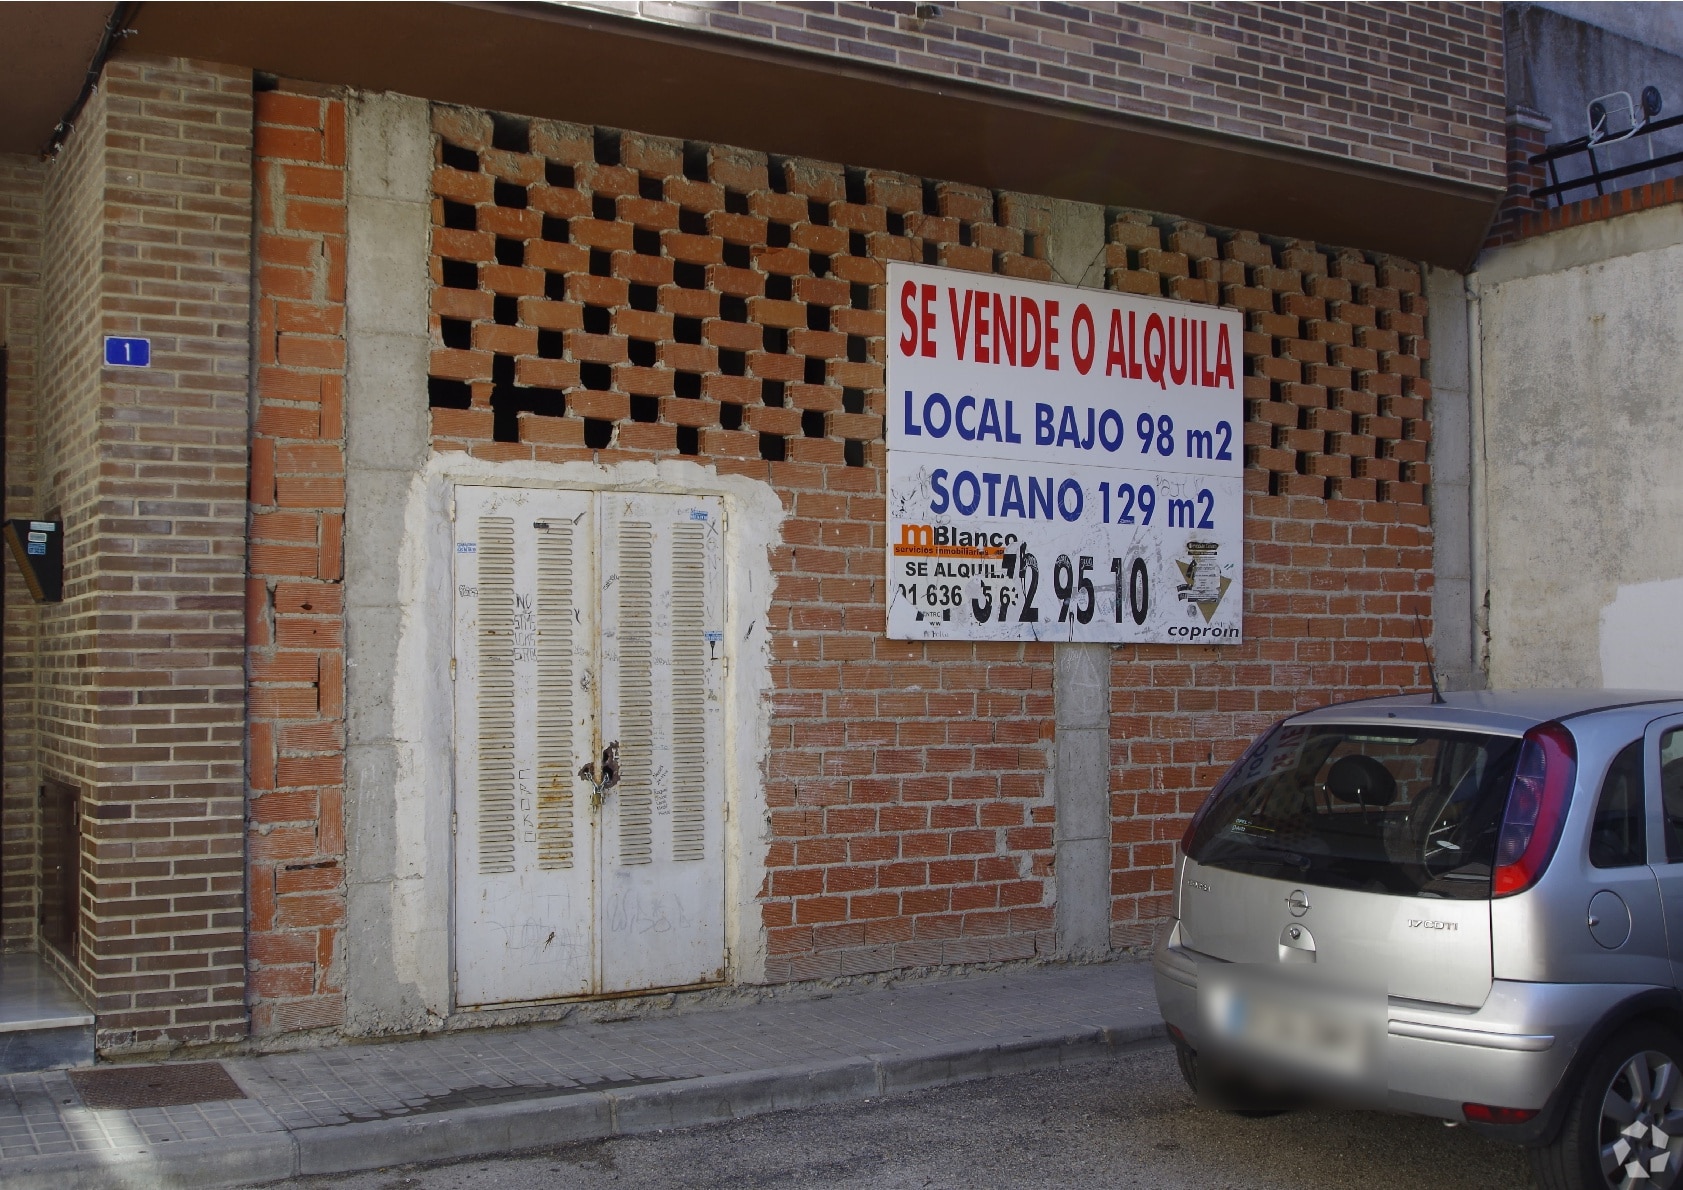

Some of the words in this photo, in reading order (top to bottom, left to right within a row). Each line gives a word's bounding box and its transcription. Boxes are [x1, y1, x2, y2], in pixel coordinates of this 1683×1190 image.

[900, 280, 937, 358] SE
[948, 287, 1060, 371] VENDE
[1071, 303, 1096, 376] O
[1106, 308, 1235, 390] ALQUILA
[124, 342, 130, 362] 1
[904, 390, 1021, 444] LOCAL
[1035, 402, 1124, 452] BAJO
[1136, 412, 1175, 456] 98
[1186, 420, 1233, 461] m2
[930, 468, 1084, 522] SOTANO
[1098, 481, 1156, 526] 129
[1168, 489, 1215, 530] m2
[895, 546, 934, 554] servicios
[905, 562, 928, 577] SE
[926, 584, 962, 606] 636
[1053, 554, 1095, 624] 95
[1111, 557, 1149, 625] 10
[1167, 626, 1240, 640] coproin
